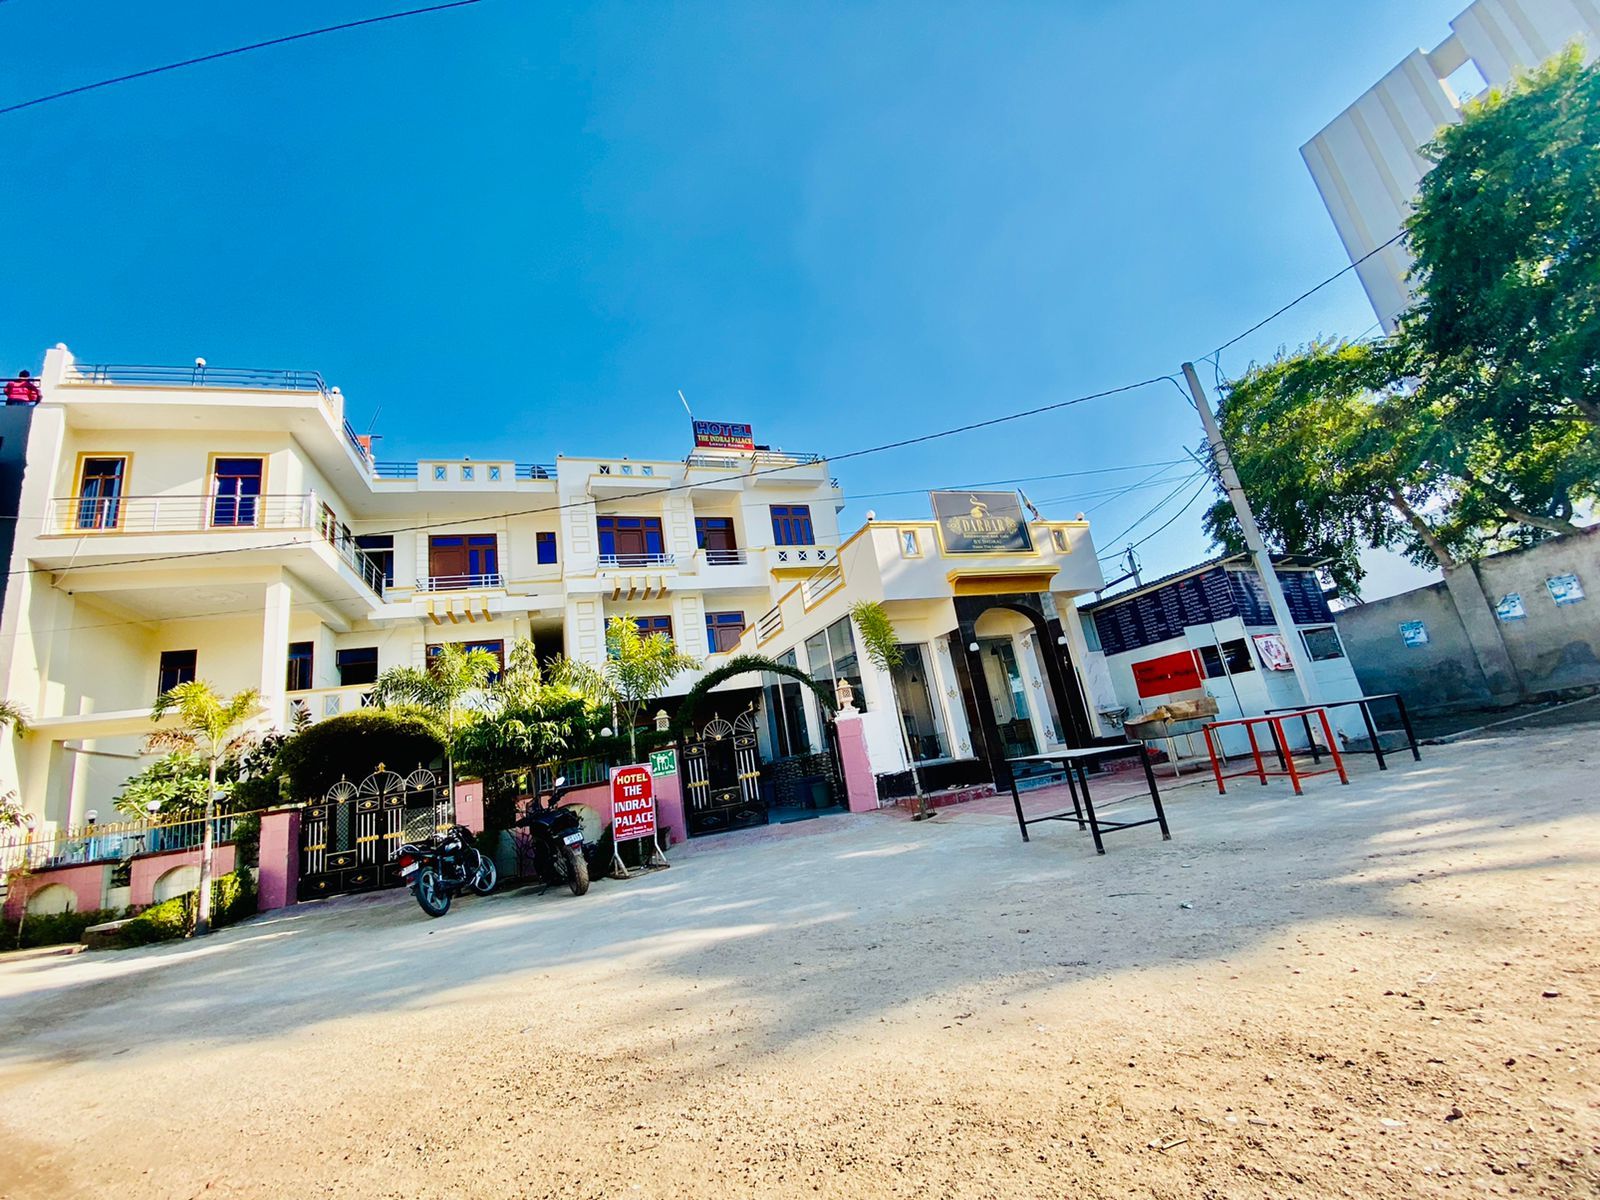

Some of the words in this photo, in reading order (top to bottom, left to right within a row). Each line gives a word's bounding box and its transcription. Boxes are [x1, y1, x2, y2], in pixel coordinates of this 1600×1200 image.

[696, 422, 751, 436] HOTEL
[962, 519, 1005, 531] DARBAR
[616, 773, 648, 785] HOTEL
[623, 784, 642, 797] THE
[614, 797, 652, 813] INDRAJ
[615, 811, 654, 828] PALACE
